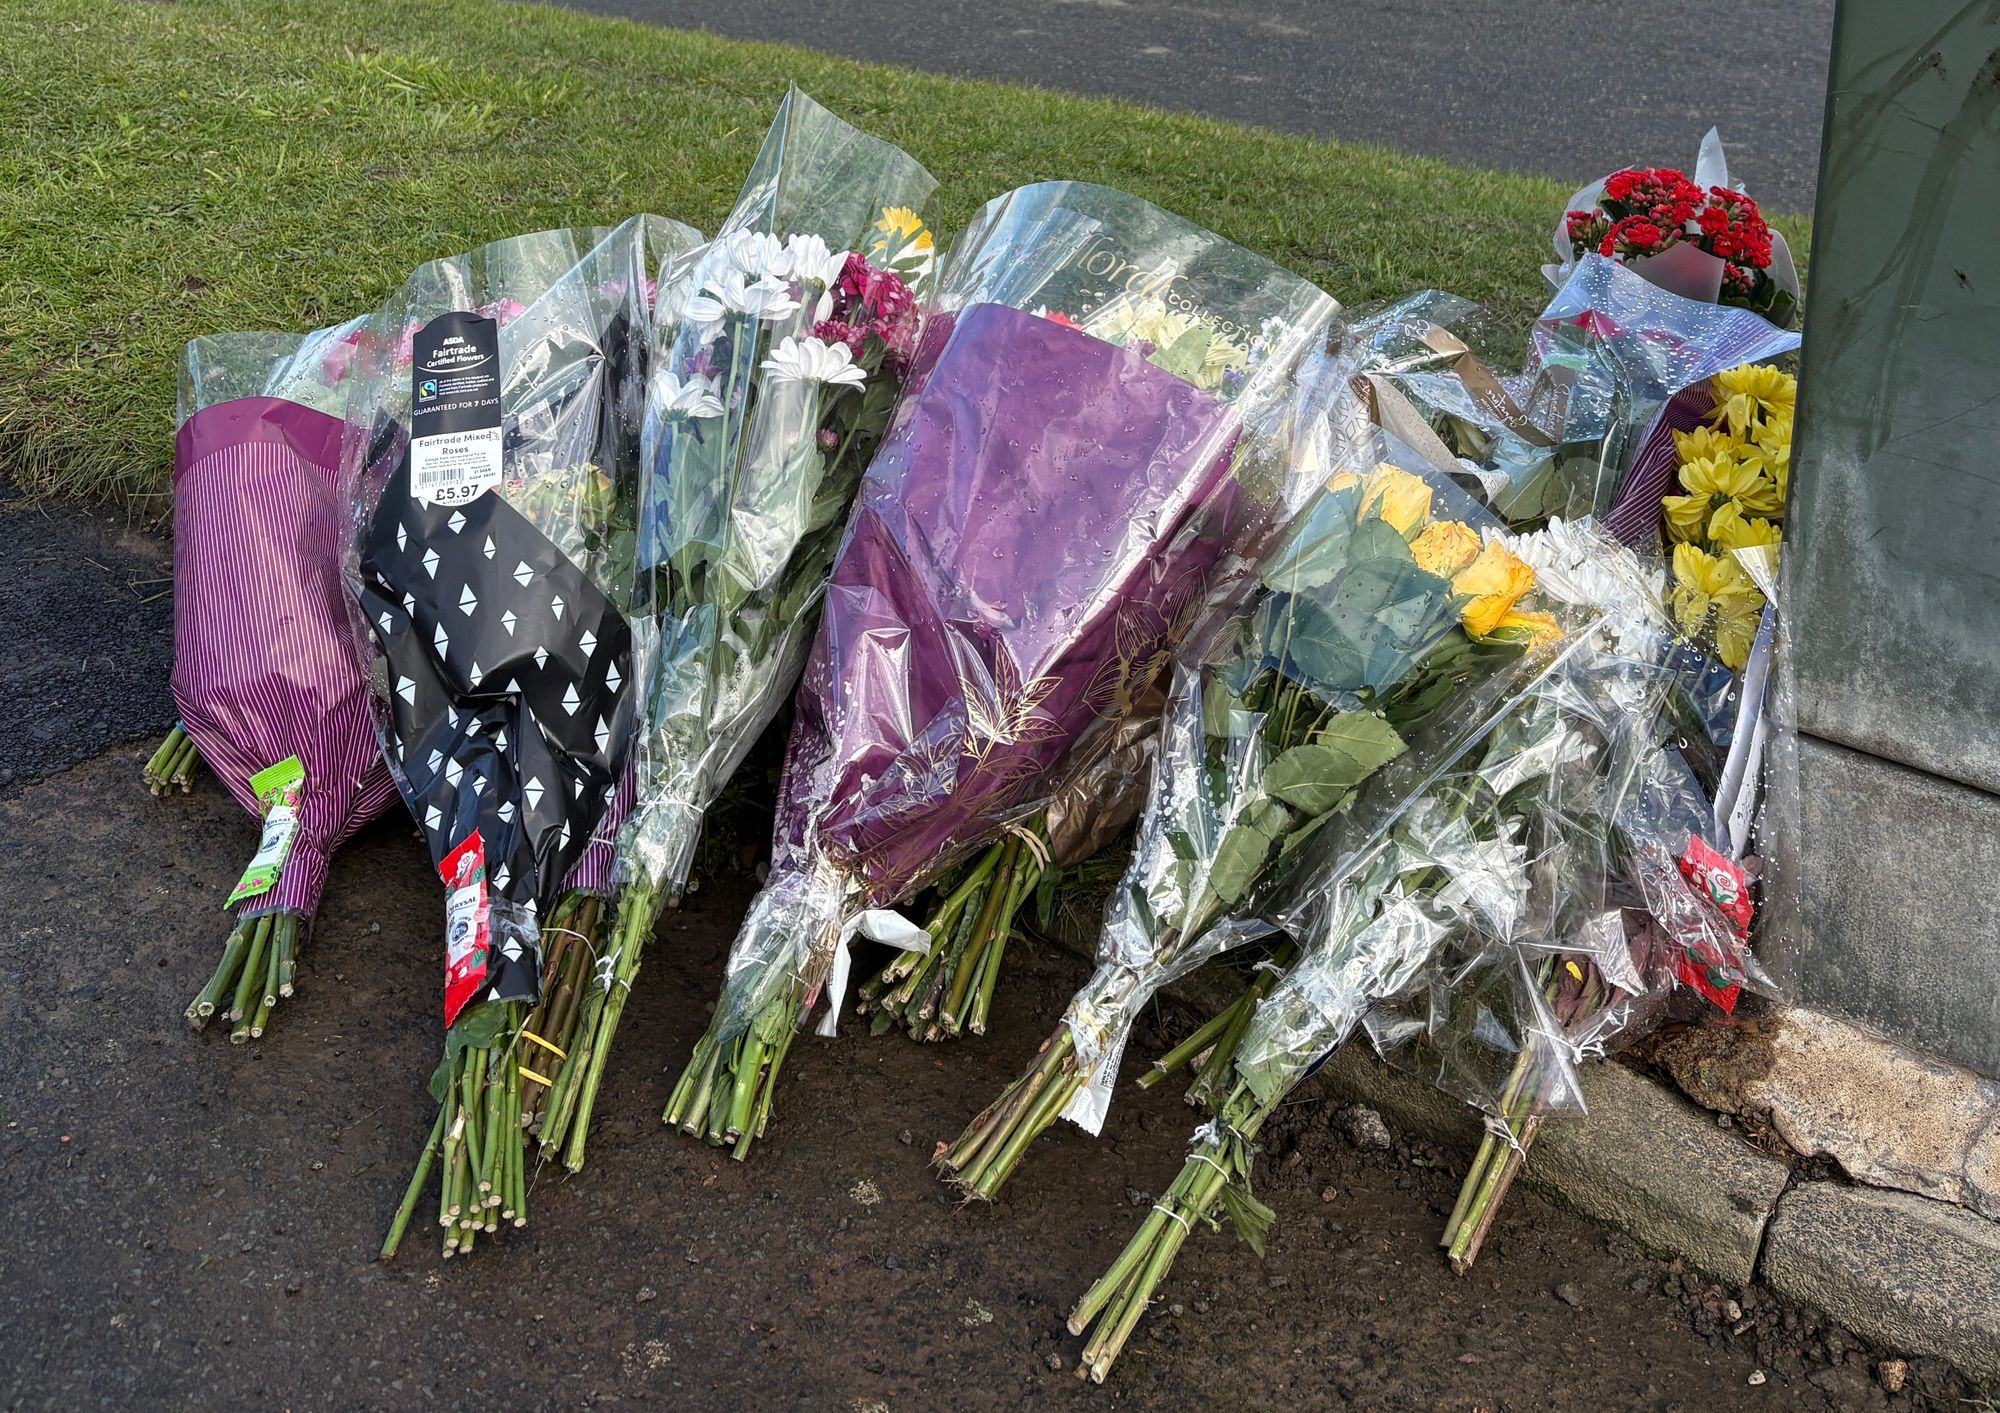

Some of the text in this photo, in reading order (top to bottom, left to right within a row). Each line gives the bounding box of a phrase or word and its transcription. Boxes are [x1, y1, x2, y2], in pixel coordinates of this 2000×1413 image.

[443, 336, 465, 345] ASDA
[432, 344, 477, 358] Fairtrade
[426, 353, 485, 368] Certified Flowers
[413, 403, 457, 416] GUARANTEED
[459, 401, 473, 409] FOR
[481, 398, 499, 406] DAYS
[419, 430, 492, 447] Fairtrade Mixed
[442, 446, 469, 455] Roses
[435, 484, 479, 501] £5.97
